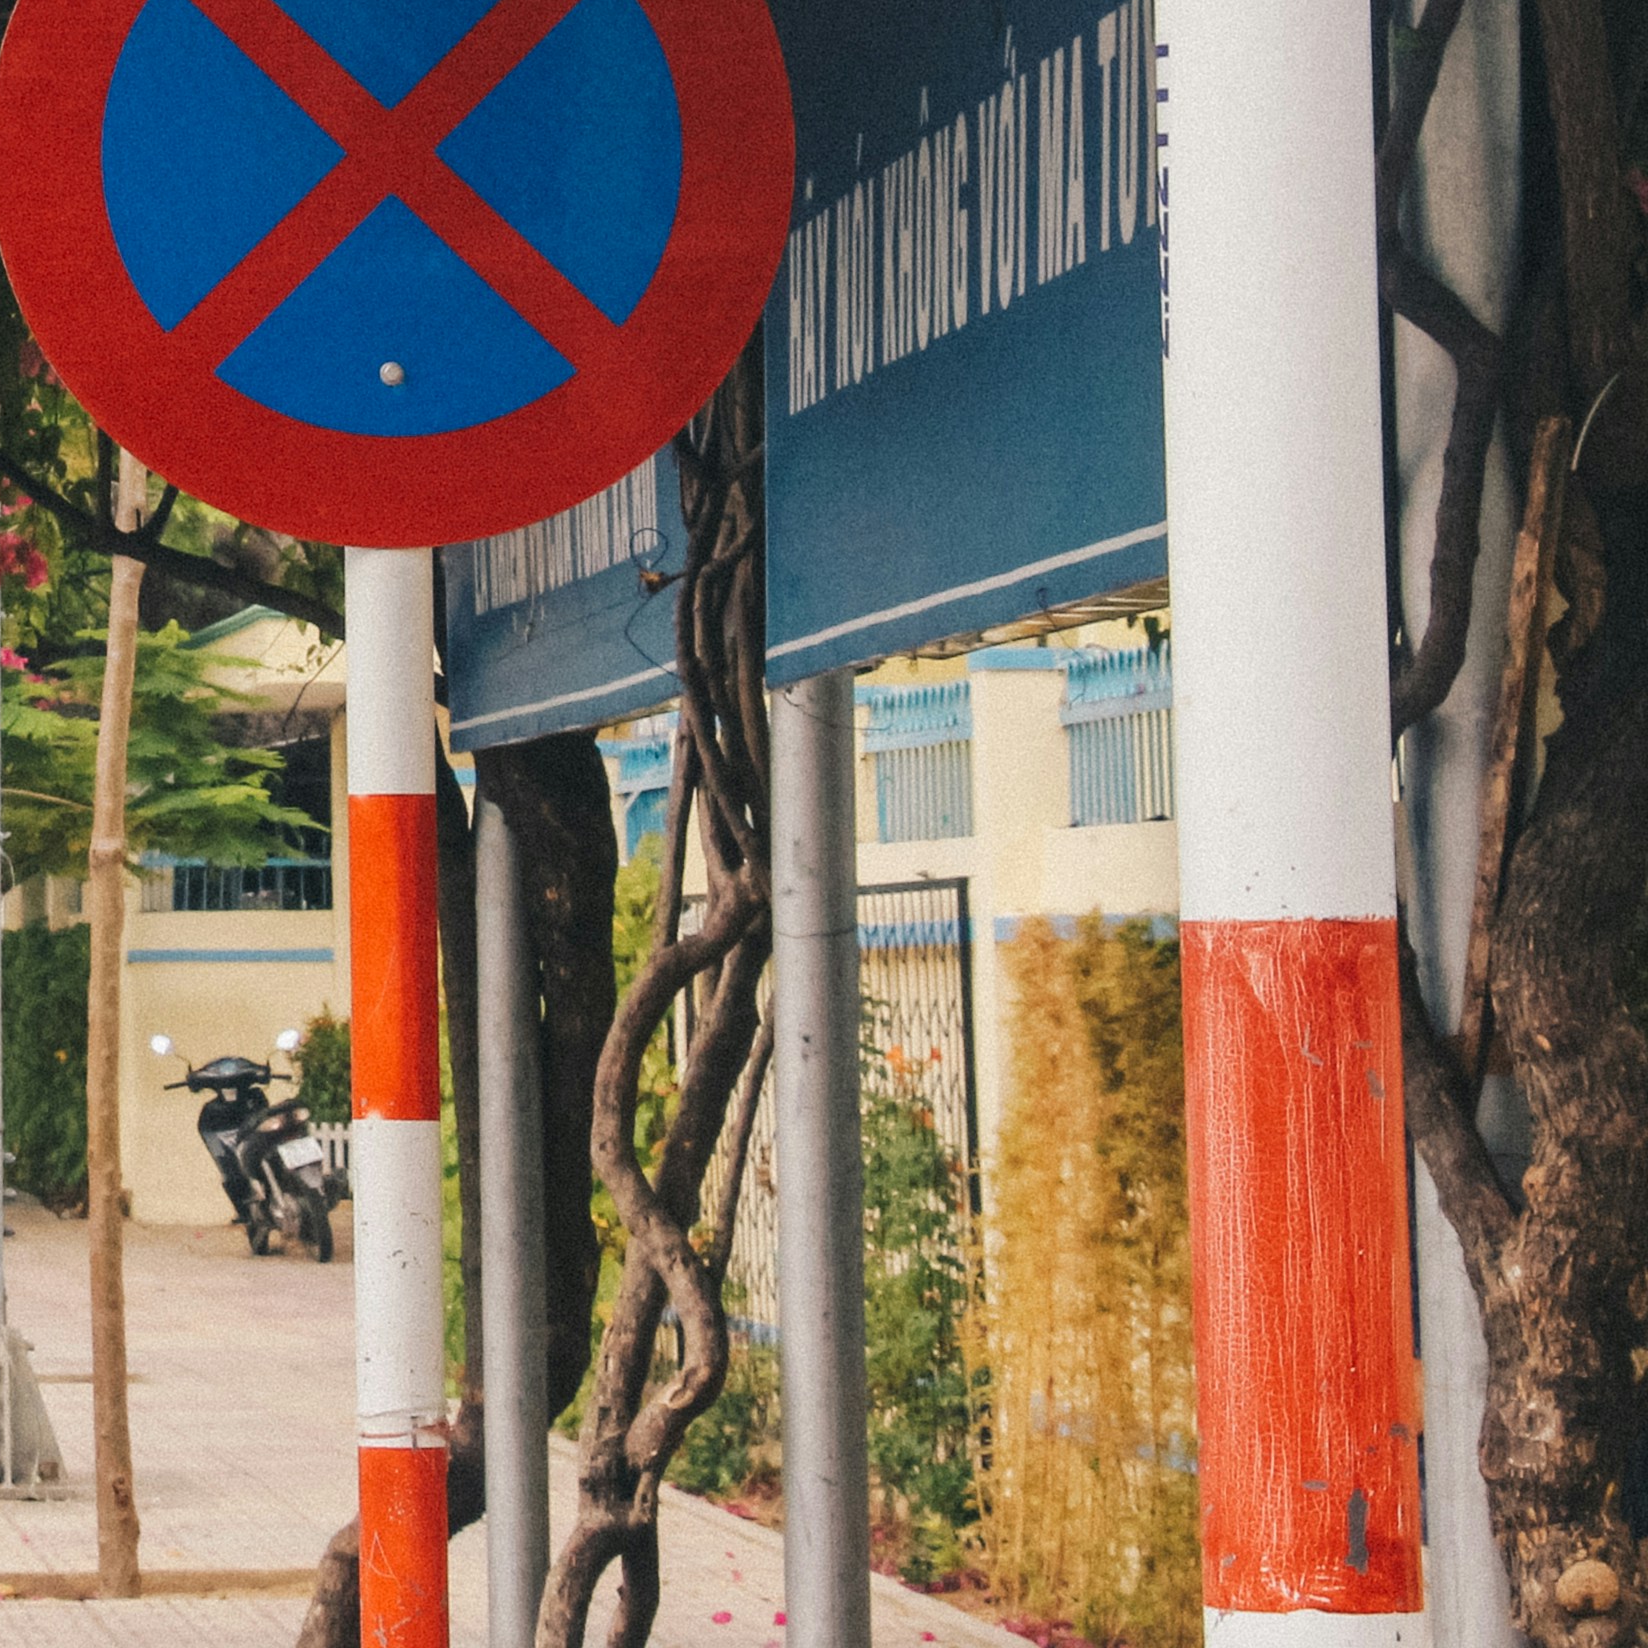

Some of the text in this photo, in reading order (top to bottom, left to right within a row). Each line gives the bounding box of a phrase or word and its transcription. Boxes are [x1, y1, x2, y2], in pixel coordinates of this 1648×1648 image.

[835, 132, 874, 391] NÓI
[882, 86, 969, 366] KHÔNG
[978, 25, 1027, 316] VỚI
[1038, 35, 1087, 286] MA
